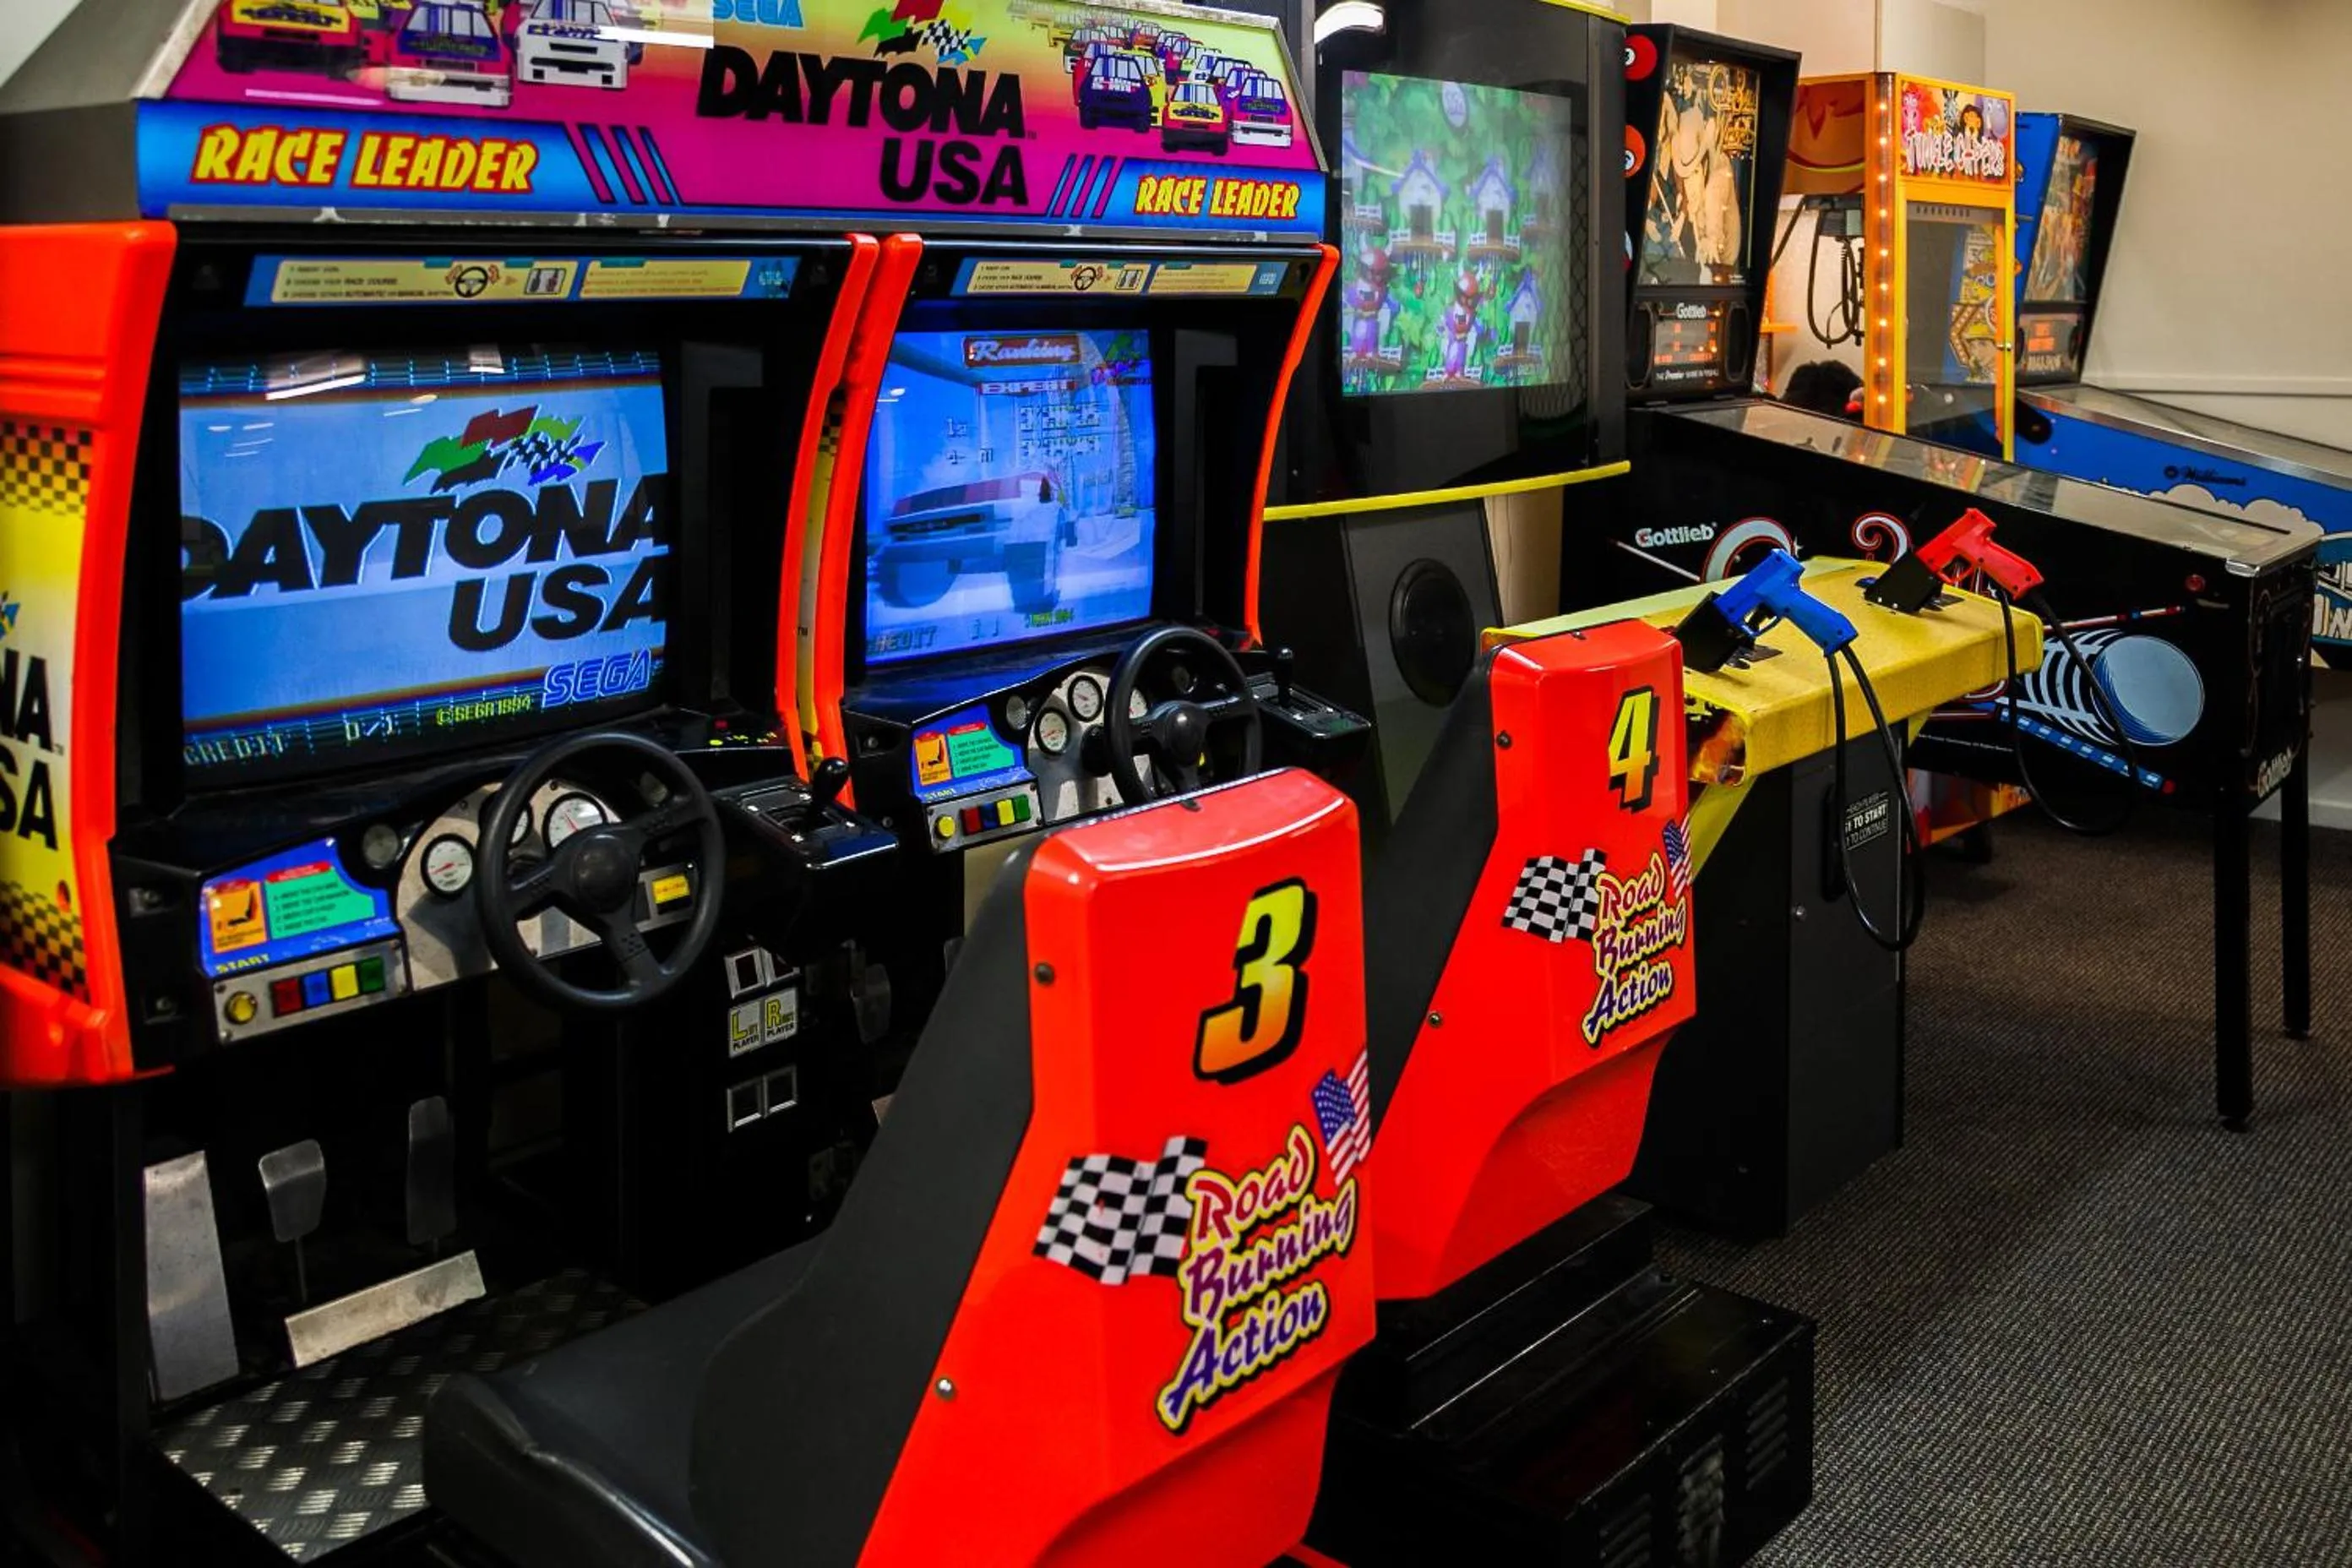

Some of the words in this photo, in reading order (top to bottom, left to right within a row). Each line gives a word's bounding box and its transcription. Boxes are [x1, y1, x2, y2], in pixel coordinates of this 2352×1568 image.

[695, 45, 1026, 139] DAYTONA
[191, 124, 346, 186] RACE
[348, 132, 539, 194] LEADER
[879, 139, 1029, 206] USA
[1134, 174, 1204, 216] RACE
[1206, 177, 1303, 220] LEADER
[1635, 523, 1715, 548] Gottlieb
[448, 557, 667, 652] USA
[542, 649, 651, 707] SEGA
[182, 732, 286, 766] CREDIT
[1608, 685, 1660, 812] 4
[1854, 814, 1864, 829] TO
[1865, 803, 1886, 825] START
[1597, 852, 1663, 924] Road
[215, 953, 270, 974] START
[1593, 897, 1686, 978] Burning
[1193, 876, 1317, 1086] 3
[1582, 960, 1672, 1046] Action
[1188, 1123, 1315, 1250] Road
[1179, 1178, 1358, 1327] Burning
[1156, 1282, 1328, 1431] Action
